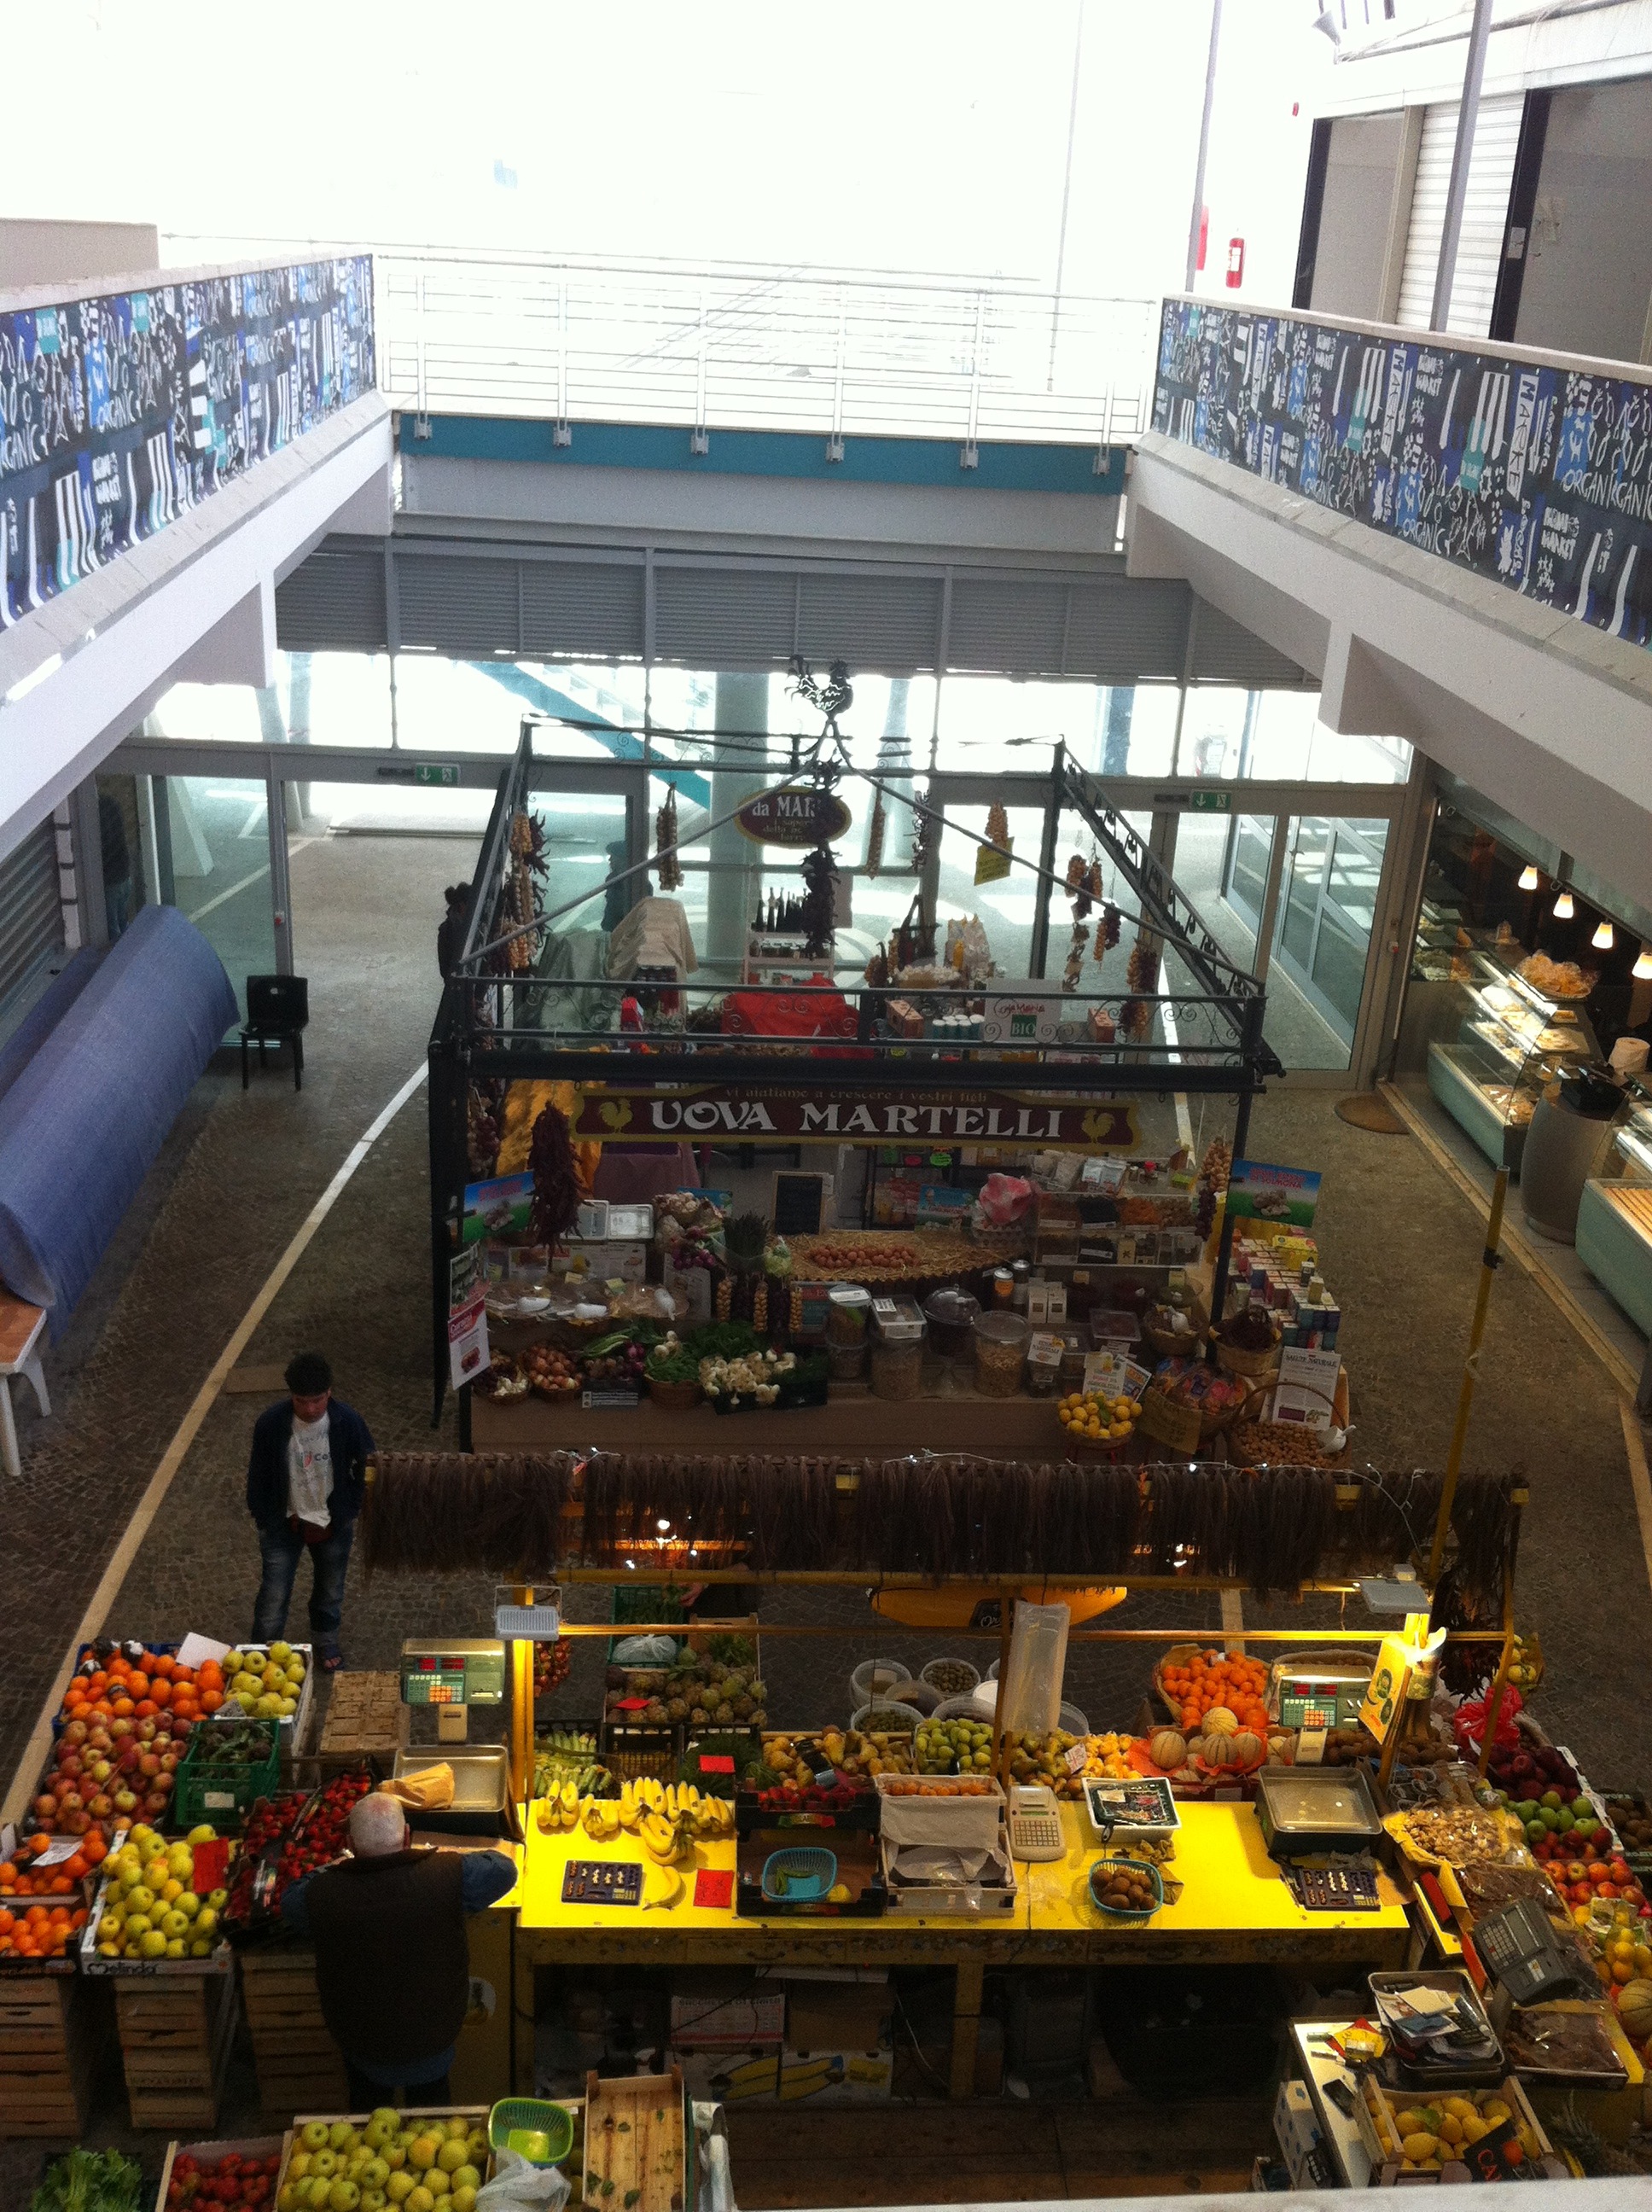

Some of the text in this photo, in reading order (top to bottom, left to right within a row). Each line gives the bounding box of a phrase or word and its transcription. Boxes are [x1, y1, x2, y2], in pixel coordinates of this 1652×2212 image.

[1402, 516, 1446, 556] ORGANIC
[752, 802, 770, 817] da
[1012, 1022, 1037, 1035] BIO
[651, 1101, 1063, 1138] UOVA MARTELLI
